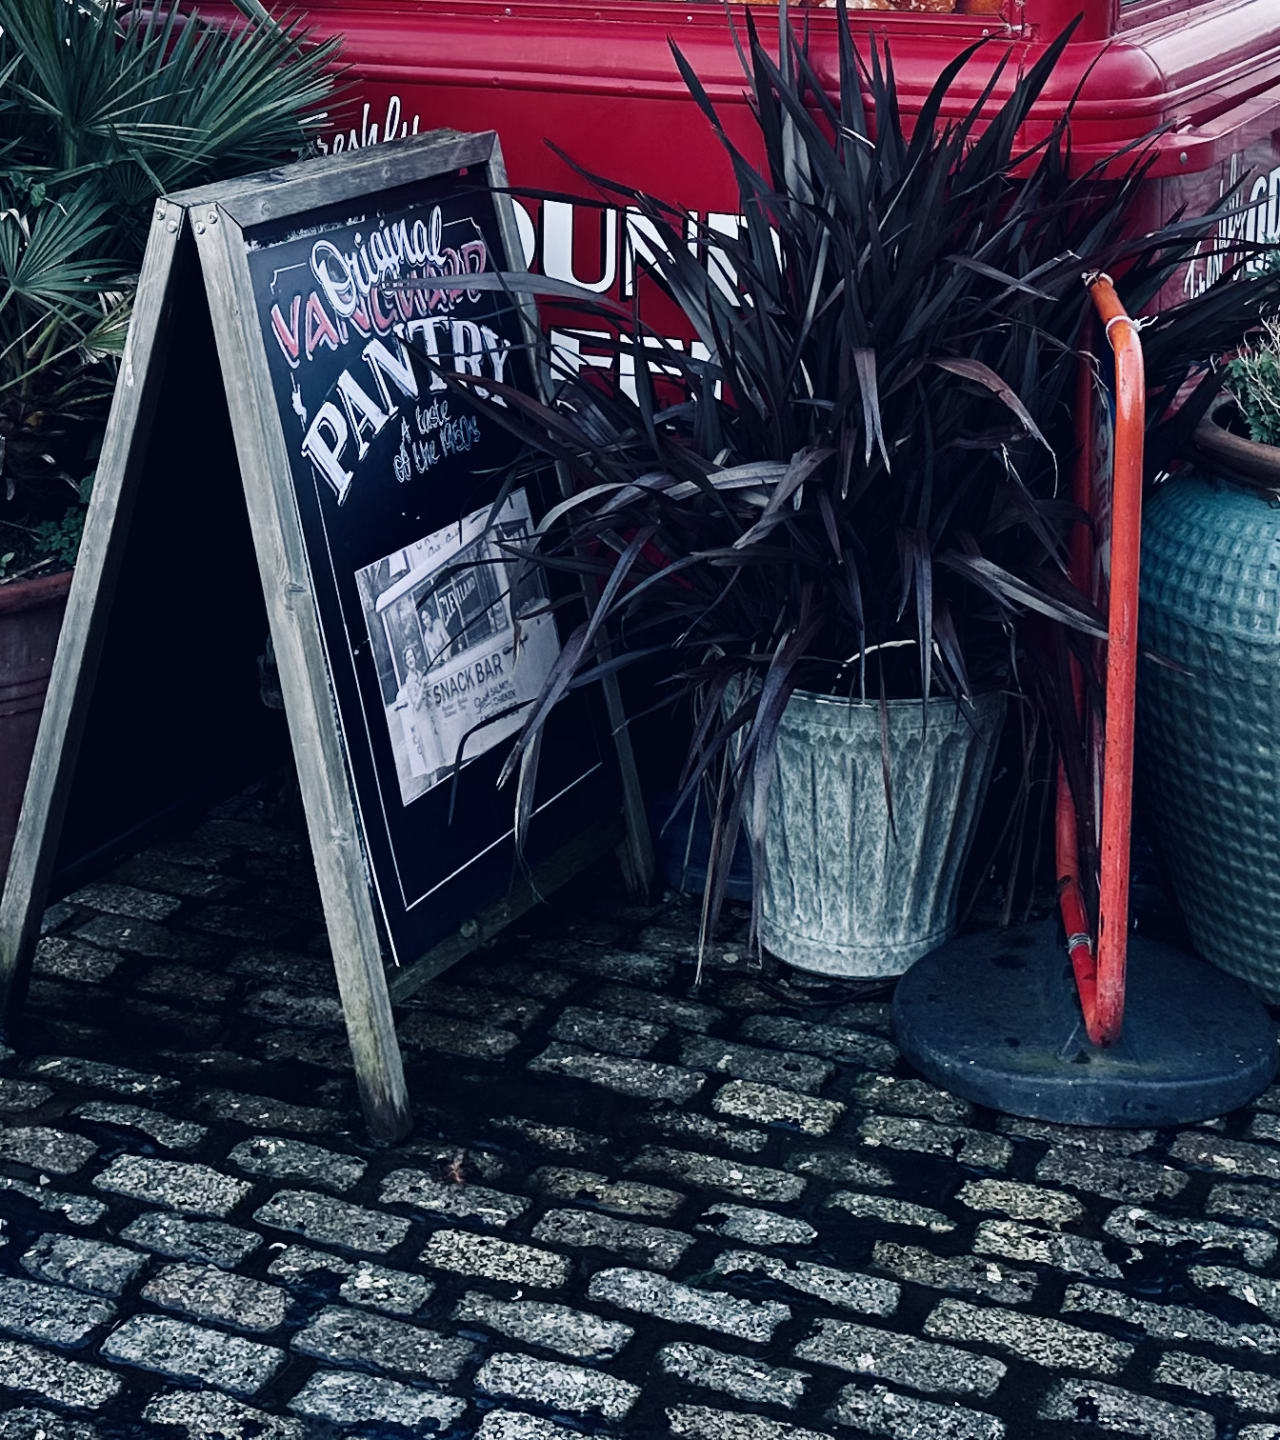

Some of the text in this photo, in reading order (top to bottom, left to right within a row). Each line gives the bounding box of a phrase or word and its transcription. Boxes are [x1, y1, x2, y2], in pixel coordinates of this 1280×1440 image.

[309, 205, 447, 318] Original
[300, 316, 513, 505] PANTRY
[415, 396, 452, 436] taste
[411, 440, 440, 475] the
[433, 667, 476, 704] SNACK
[475, 653, 504, 684] BAR
